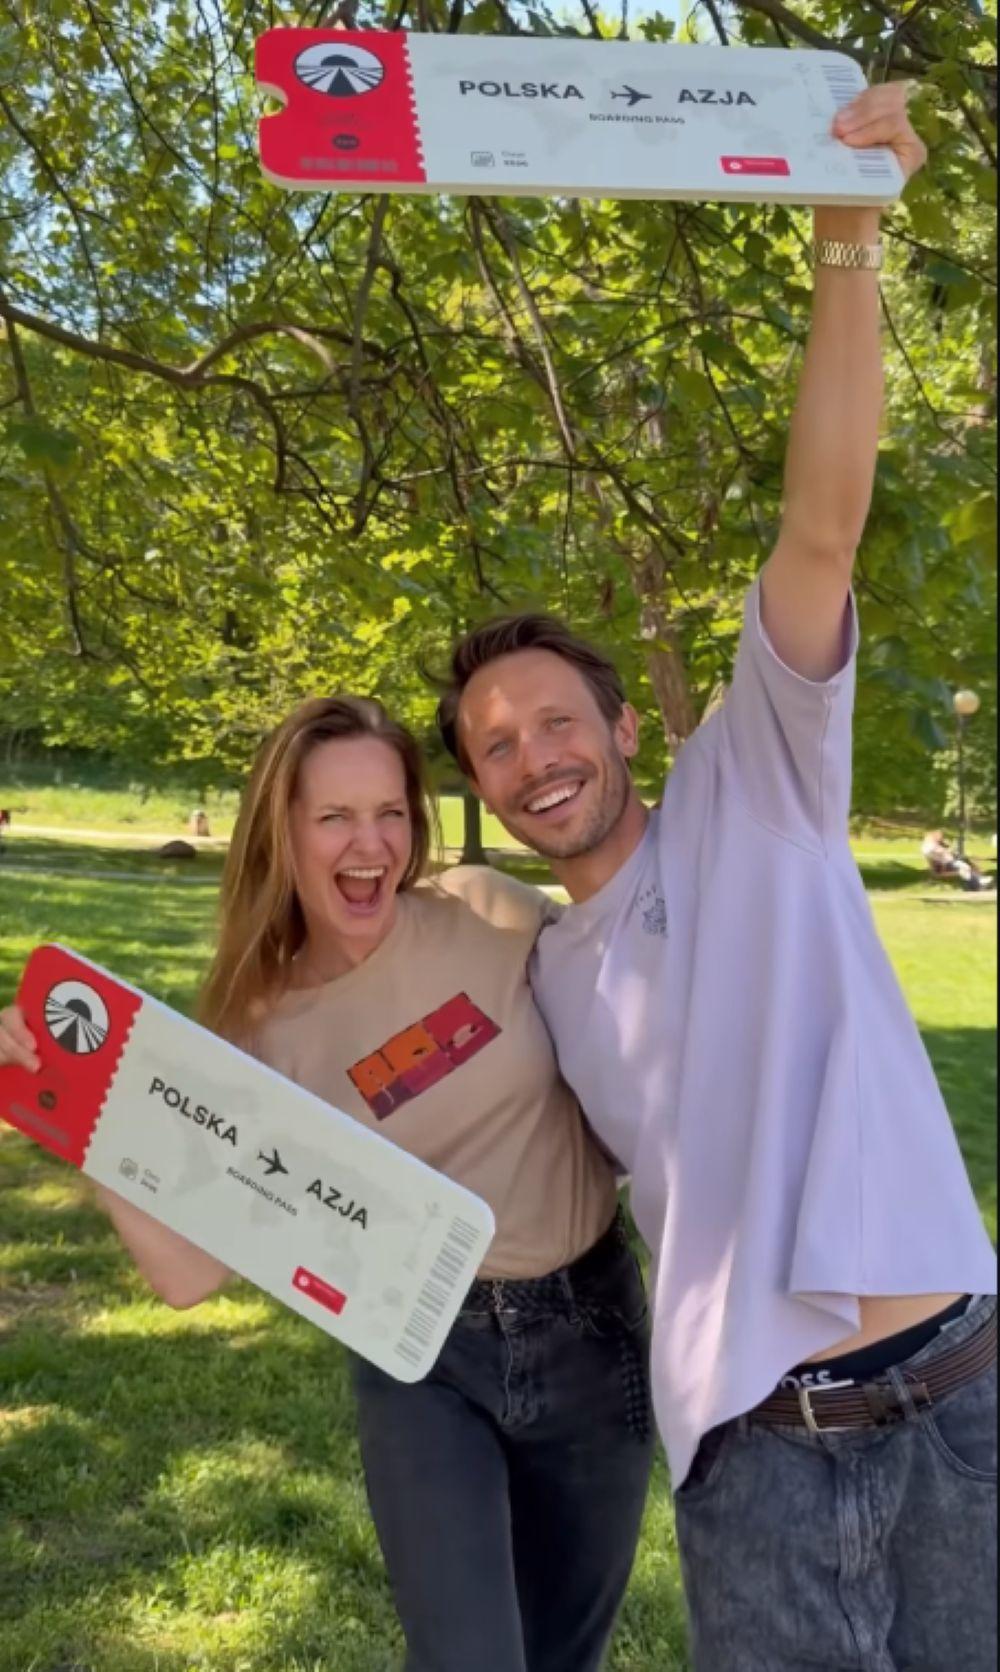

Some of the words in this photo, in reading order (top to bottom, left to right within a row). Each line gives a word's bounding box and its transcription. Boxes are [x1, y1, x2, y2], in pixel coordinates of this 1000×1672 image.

[459, 80, 585, 100] POLSKA
[678, 88, 758, 106] AZJA
[589, 112, 654, 124] BOARDING
[149, 1077, 239, 1147] POLSKA
[306, 1178, 369, 1230] AZJA
[226, 1166, 274, 1202] BOARDING
[274, 1196, 298, 1217] PASS
[780, 1369, 834, 1388] OSS
